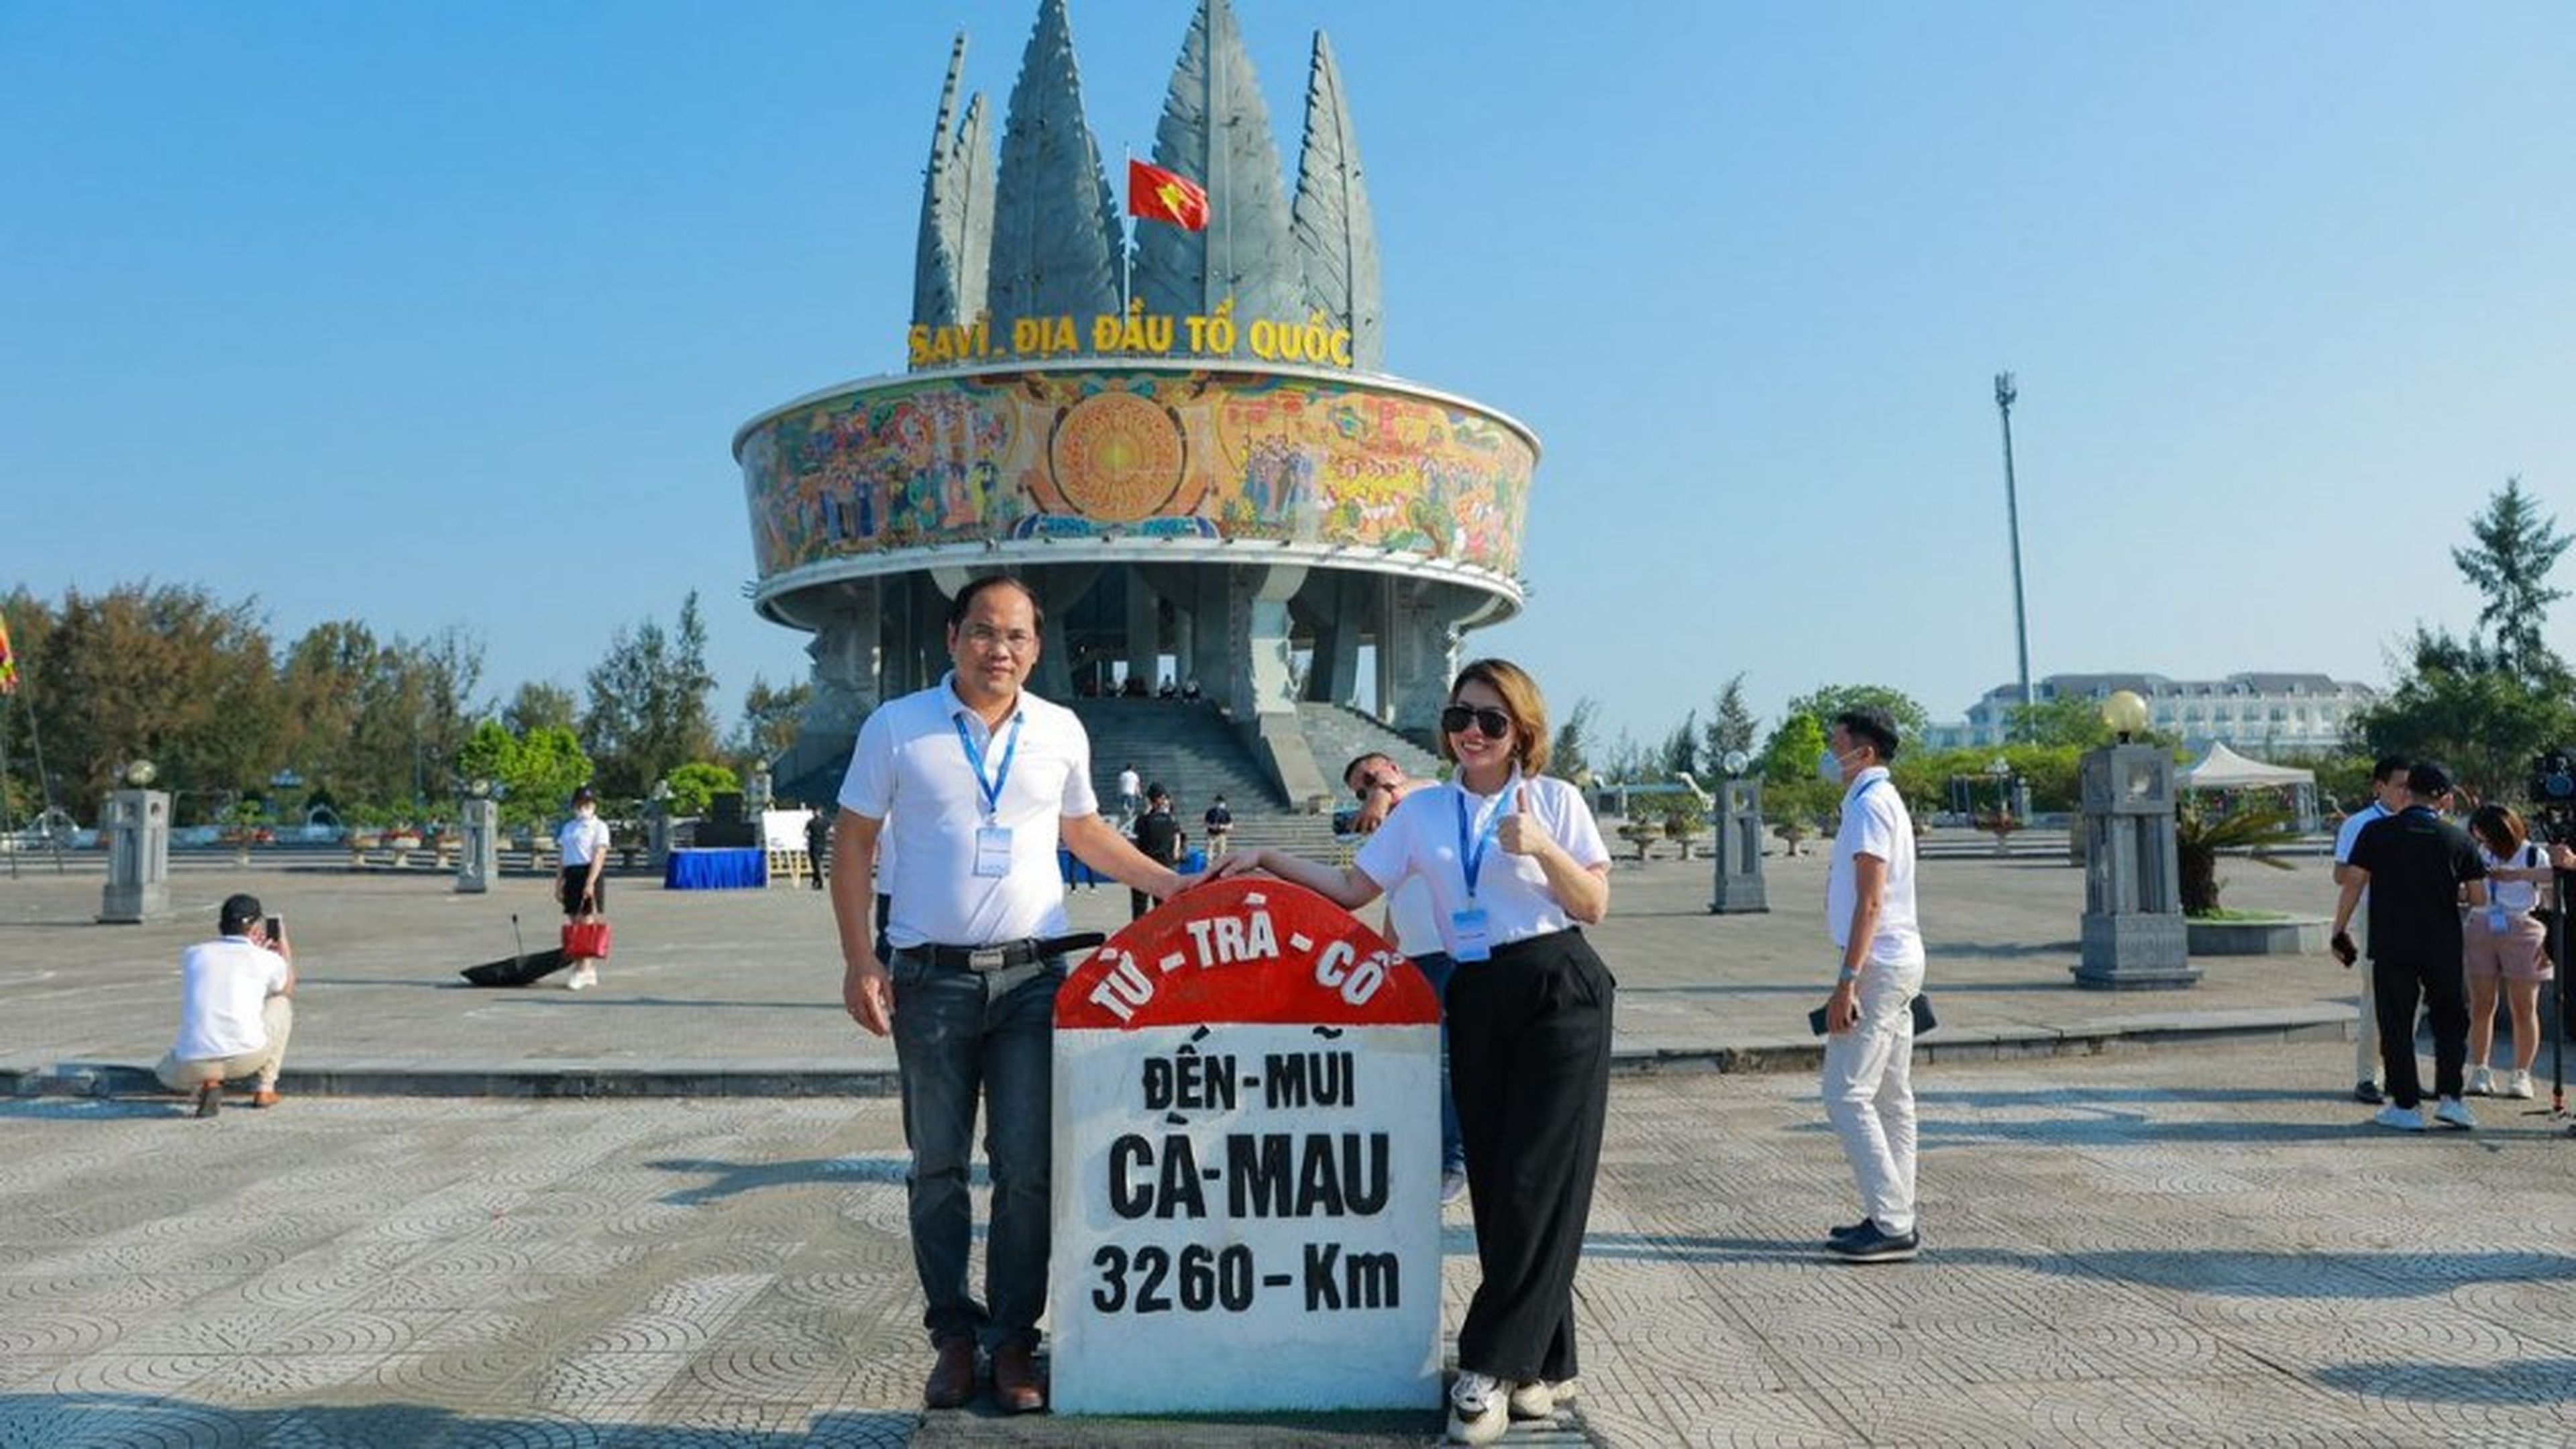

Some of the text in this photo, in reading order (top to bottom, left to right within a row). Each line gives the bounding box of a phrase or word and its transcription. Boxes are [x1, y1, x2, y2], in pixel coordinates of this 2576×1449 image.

[1092, 297, 1174, 353] ĐẦU
[1249, 308, 1351, 369] QUỐC
[1186, 892, 1279, 969] TRÀ
